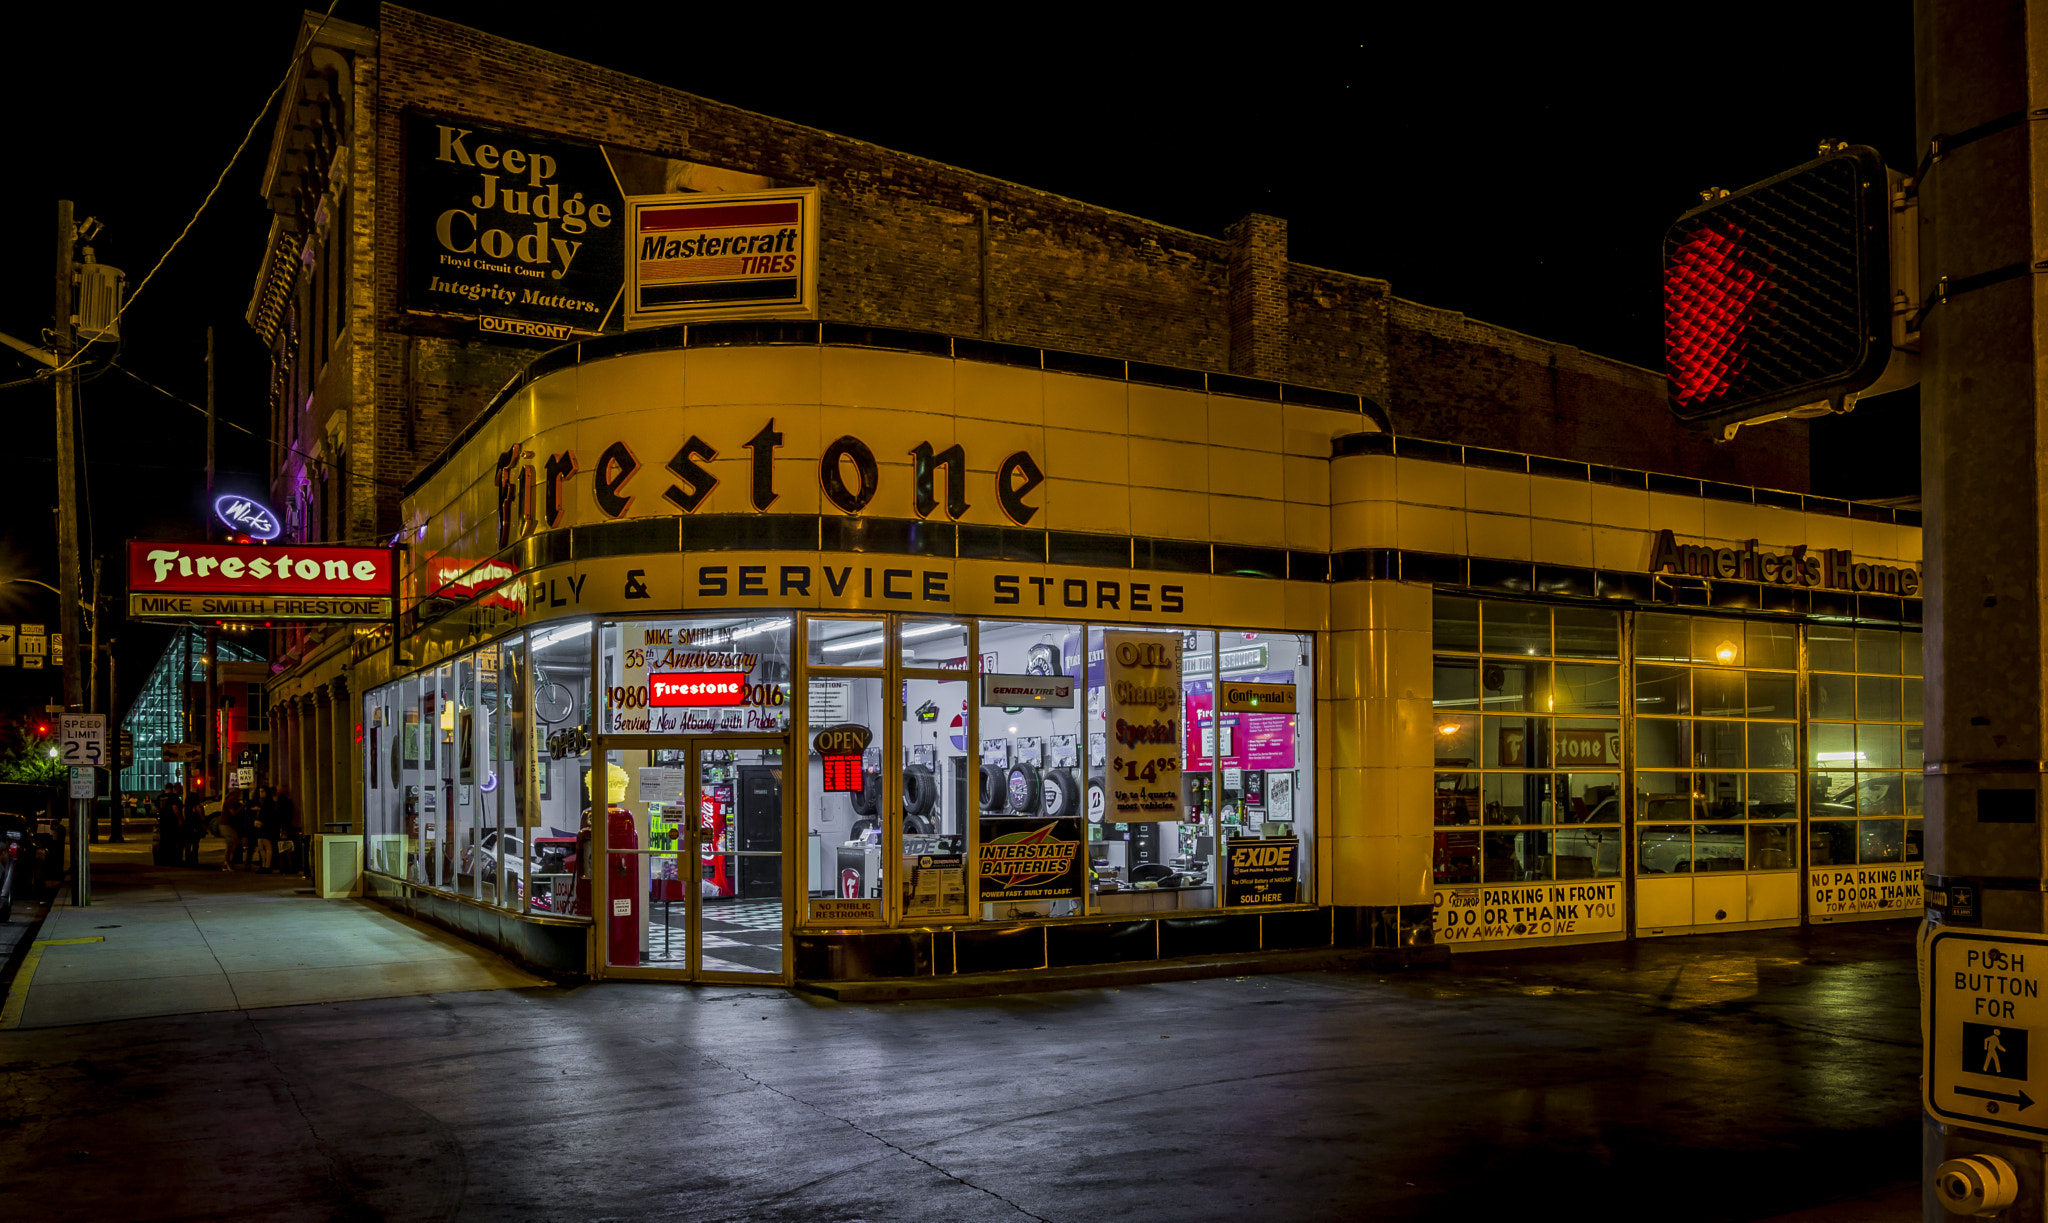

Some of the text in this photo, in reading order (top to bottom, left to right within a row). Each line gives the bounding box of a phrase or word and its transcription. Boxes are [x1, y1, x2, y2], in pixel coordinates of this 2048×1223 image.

[436, 124, 556, 186] Keep
[472, 173, 612, 234] Judge
[436, 209, 582, 278] Cody
[640, 228, 797, 261] Mastercraft
[440, 254, 546, 278] Floyd Circuit Court
[740, 254, 797, 274] TIRES
[430, 276, 600, 313] Integrity Matters.
[482, 318, 567, 339] OUTFRONT
[496, 418, 1045, 548] Firestone
[147, 550, 376, 582] Firestone
[1649, 528, 1918, 596] America's Home
[624, 569, 650, 598] &
[699, 565, 950, 602] SERVICE
[993, 574, 1184, 614] STORES
[141, 598, 380, 614] MIKE SMITH FIRESTONE
[25, 642, 40, 653] 111
[644, 628, 673, 646] MIKE
[678, 628, 714, 646] SMITH
[624, 648, 758, 676] 35th Anniversary
[1115, 642, 1172, 668] OIL
[1225, 652, 1258, 667] SERVICE
[607, 685, 648, 710] 1980
[654, 682, 739, 698] Firestone
[740, 684, 784, 708] 2016
[1114, 678, 1176, 712] Change
[1228, 688, 1284, 704] Continental
[657, 712, 677, 730] New
[680, 712, 716, 734] Albany
[720, 714, 742, 730] with
[1116, 717, 1176, 748] Special
[64, 741, 101, 759] 25
[551, 727, 584, 760] OPEN
[819, 732, 864, 750] OPEN
[72, 769, 78, 777] 2
[1115, 790, 1128, 800] Up
[1140, 786, 1146, 800] 4
[1148, 791, 1175, 800] quarts
[1117, 801, 1173, 810] most vehicles
[979, 844, 1074, 859] INTERSTATE
[1231, 847, 1292, 867] EXIDE
[982, 859, 1068, 875] BATTERIES
[1812, 873, 1829, 886] NO
[1835, 870, 1896, 886] PARKING
[1240, 893, 1282, 903] SOLD HERE
[1434, 884, 1615, 908] O PARKING IN FRONT
[1463, 898, 1479, 908] DROP
[1816, 885, 1920, 902] OF DOOR THANK
[816, 910, 875, 919] RESTROOMS
[836, 902, 871, 910] PUBLIC
[1448, 909, 1508, 926] DOOR
[1513, 904, 1579, 923] THANK
[1585, 903, 1616, 918] YOU
[1826, 902, 1845, 913] TOW
[1888, 898, 1922, 909] ZONE
[1473, 924, 1516, 938] AWAY
[1527, 921, 1576, 934] ZONE
[1968, 950, 2024, 972] PUSH
[1955, 972, 2037, 998] BUTTON
[1976, 998, 2015, 1019] FOR
